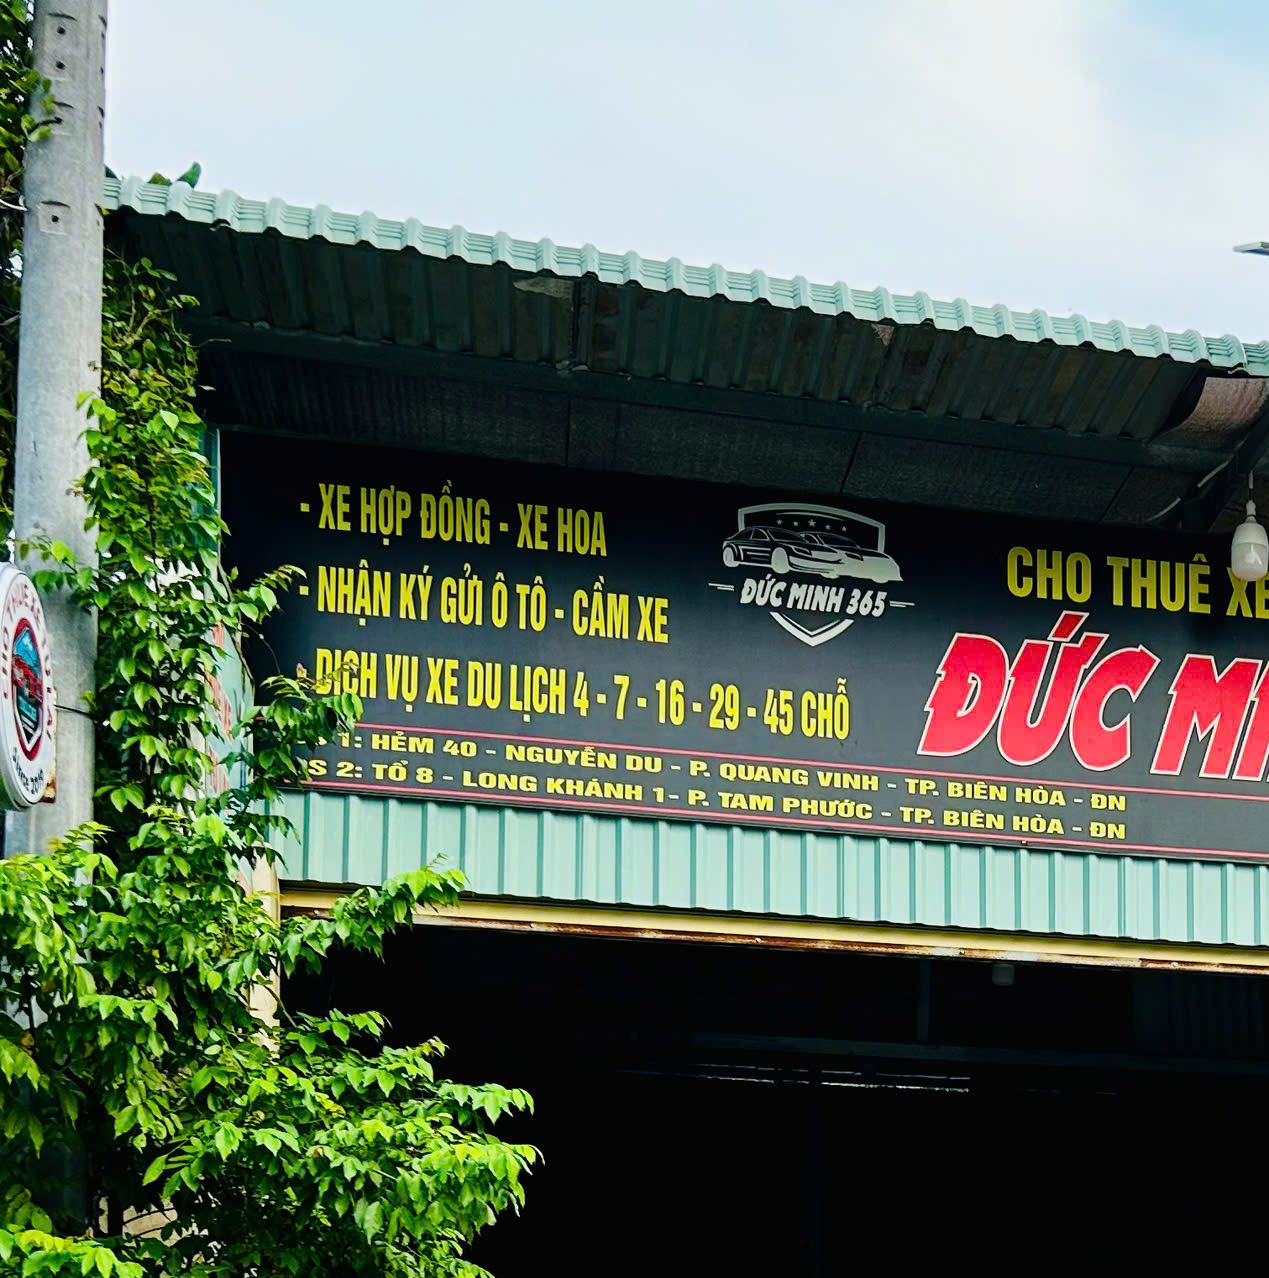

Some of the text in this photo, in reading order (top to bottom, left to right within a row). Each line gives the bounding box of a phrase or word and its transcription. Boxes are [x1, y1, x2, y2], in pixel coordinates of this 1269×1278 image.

[318, 483, 350, 531] XE
[360, 485, 411, 545] HỢP
[420, 480, 490, 544] ĐỒNG
[517, 503, 548, 550] XE
[557, 507, 607, 556] HOA
[317, 559, 391, 626] NHẬN
[400, 565, 432, 620] KÝ
[441, 563, 483, 626] GỬI
[492, 572, 508, 628] Ô
[516, 576, 546, 632] TÔ
[572, 576, 630, 640] CẦM
[637, 596, 668, 643] XE
[740, 574, 888, 617] ĐỨC MINH 365
[1007, 546, 1092, 603] CHO
[1106, 552, 1211, 614] THUÊ
[385, 654, 418, 712] VỤ
[426, 657, 459, 705] XE
[467, 660, 502, 708] DU
[510, 664, 566, 722] LỊCH
[574, 672, 589, 716] 4
[614, 674, 630, 720] 7
[656, 678, 684, 726] 16
[709, 683, 740, 730] 29
[764, 688, 792, 736] 45
[801, 678, 850, 740] CHỖ
[916, 610, 1162, 772] ĐỨC
[304, 758, 328, 776] S
[336, 761, 363, 778] 2:
[372, 760, 409, 782] TỔ
[416, 767, 434, 784] 8
[462, 770, 538, 793] LONG
[546, 776, 643, 800] KHÁNH
[688, 790, 710, 806] P.
[718, 791, 774, 812] TAM
[782, 796, 873, 820] PHƯỚC
[900, 806, 935, 824] TP.
[943, 810, 1004, 830] BIÊN
[1012, 814, 1065, 835] HÒA
[1088, 822, 1126, 840] ĐN
[371, 730, 434, 754] HẺM
[442, 740, 477, 758] 40
[505, 746, 616, 770] NGUYỄN
[625, 754, 662, 773] DU
[690, 760, 710, 777] P.
[720, 762, 809, 786] QUANG
[817, 771, 880, 792] VINH
[904, 778, 940, 796] TP.
[947, 781, 1007, 802] BIÊN
[1015, 786, 1066, 806] HÒA
[1090, 793, 1126, 812] ĐN
